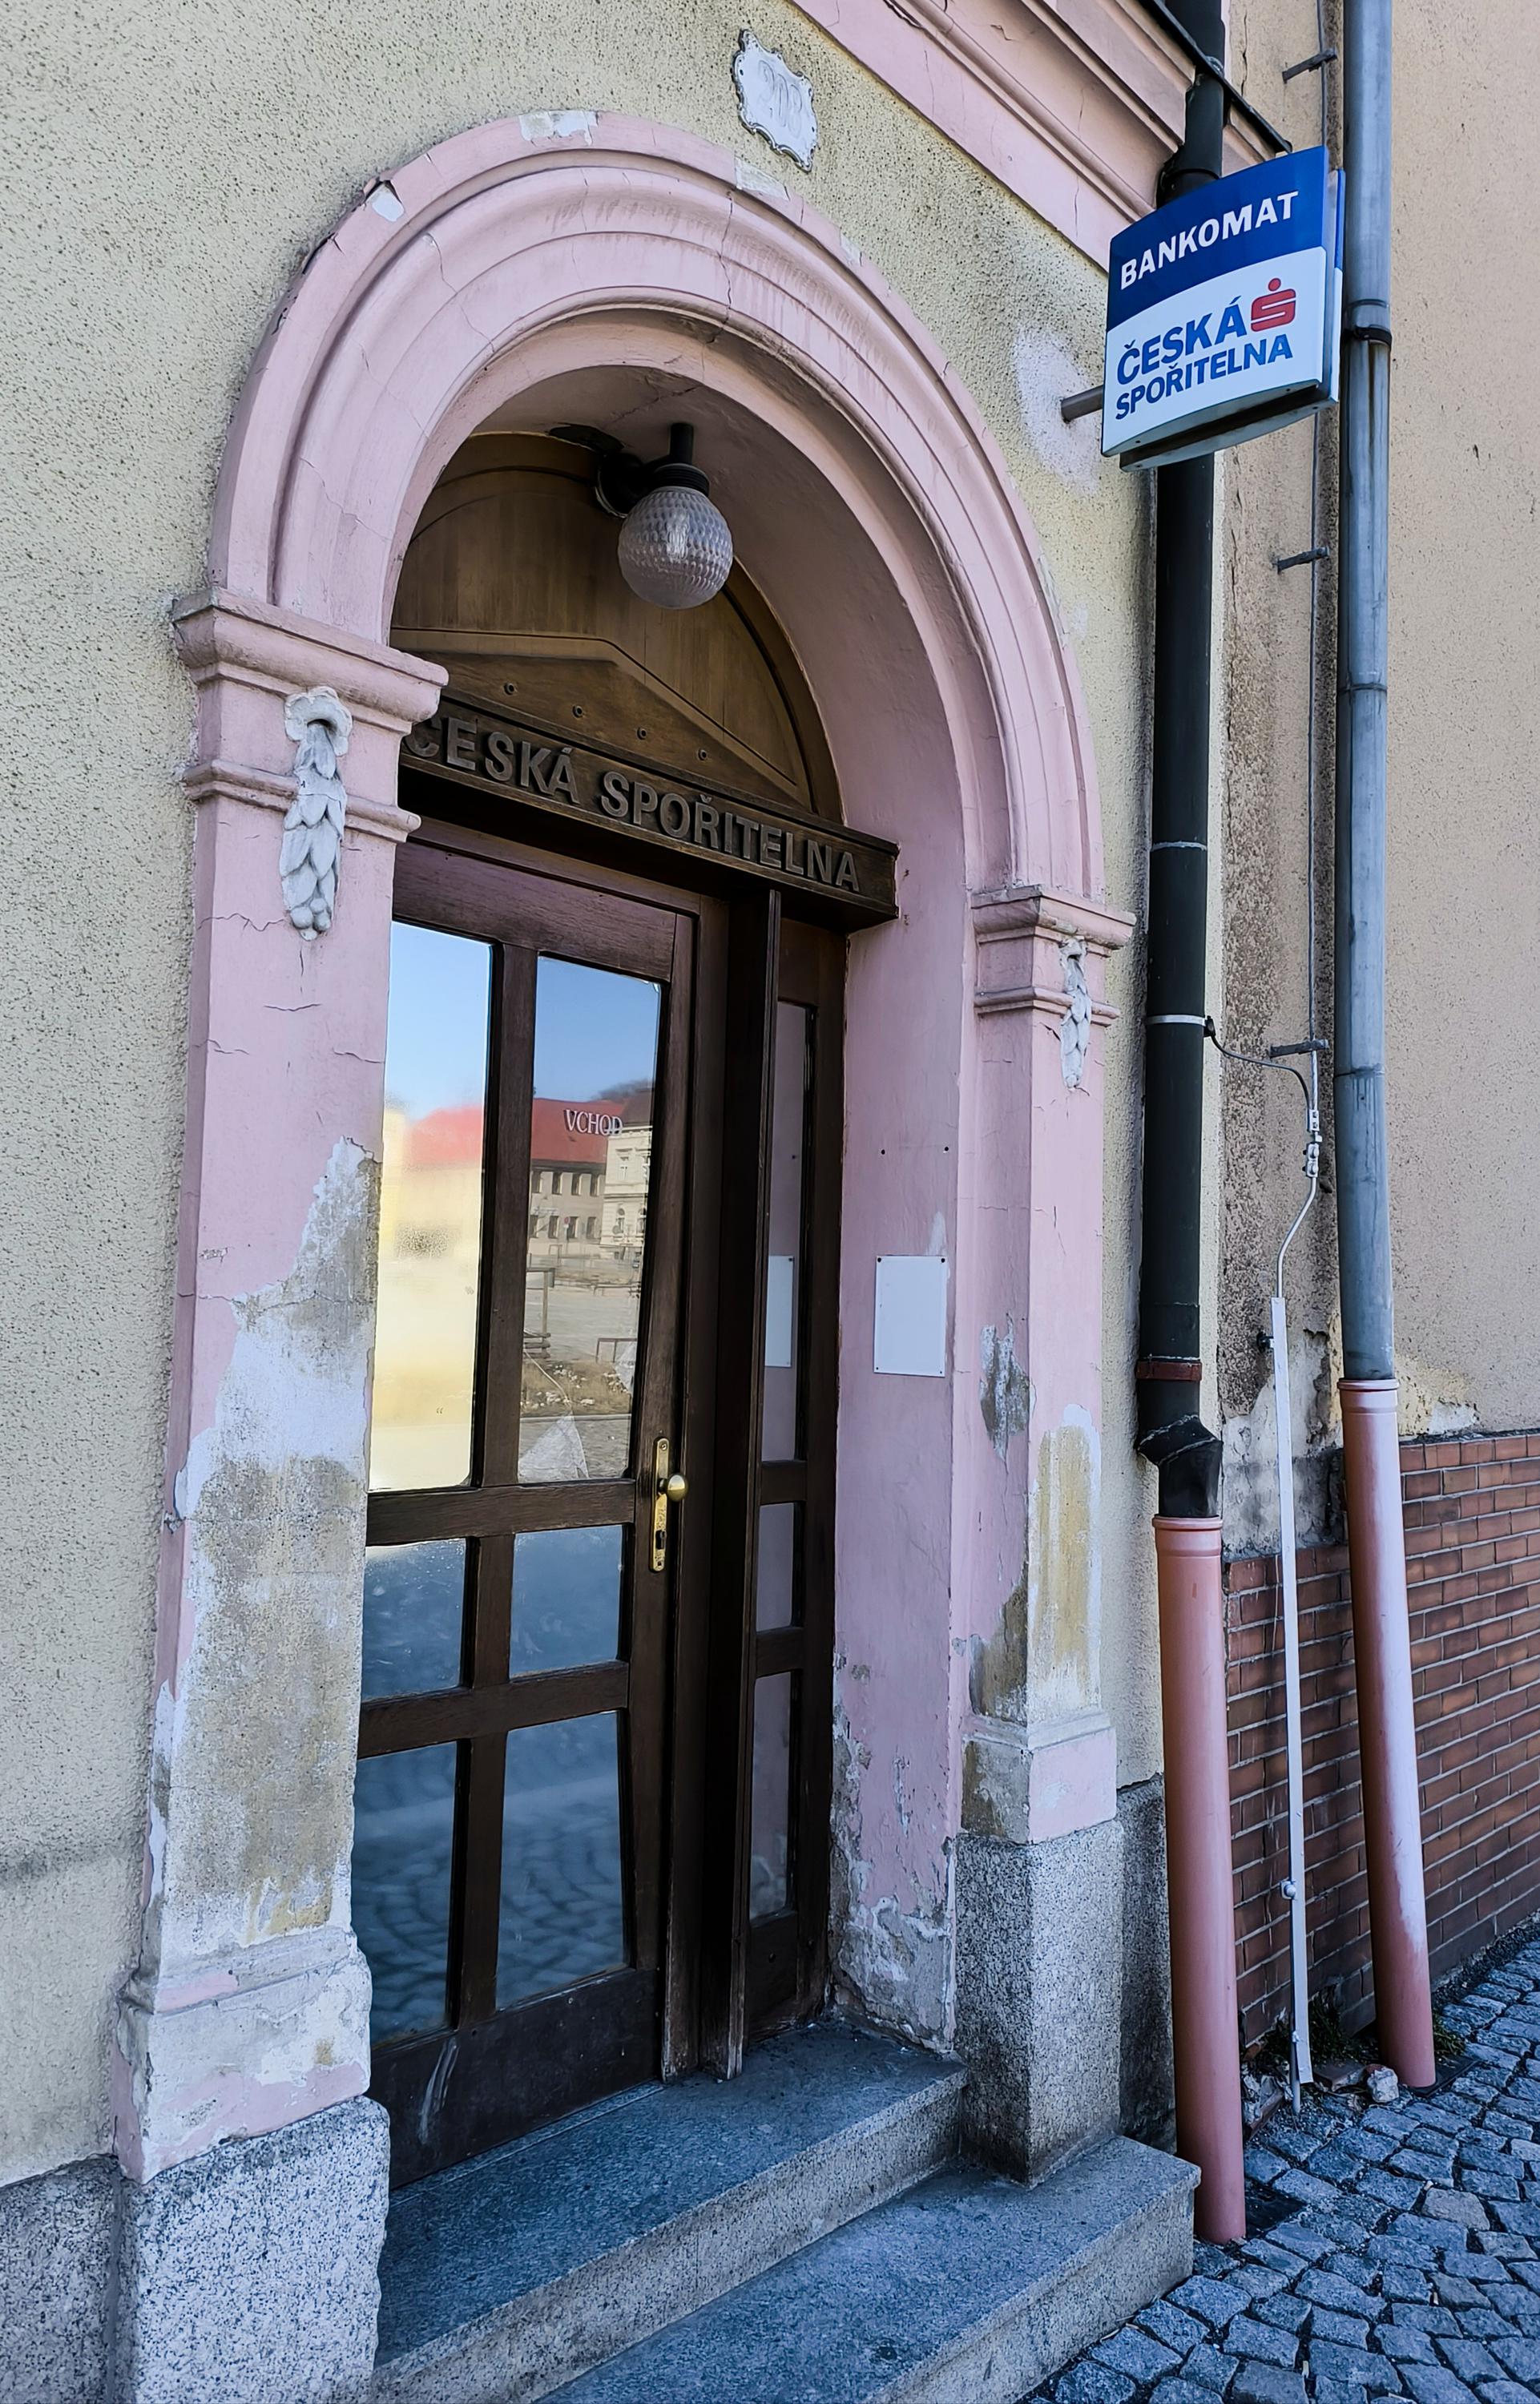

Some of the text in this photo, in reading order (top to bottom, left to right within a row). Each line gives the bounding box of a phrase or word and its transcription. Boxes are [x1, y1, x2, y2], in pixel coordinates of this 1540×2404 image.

[1121, 191, 1299, 290] BANKOMAT
[1115, 333, 1293, 420] SPOŘITELNA
[1117, 295, 1248, 385] ČESKÁ
[601, 771, 861, 892] SPOŘITELNA
[565, 1109, 623, 1136] VCHOD
